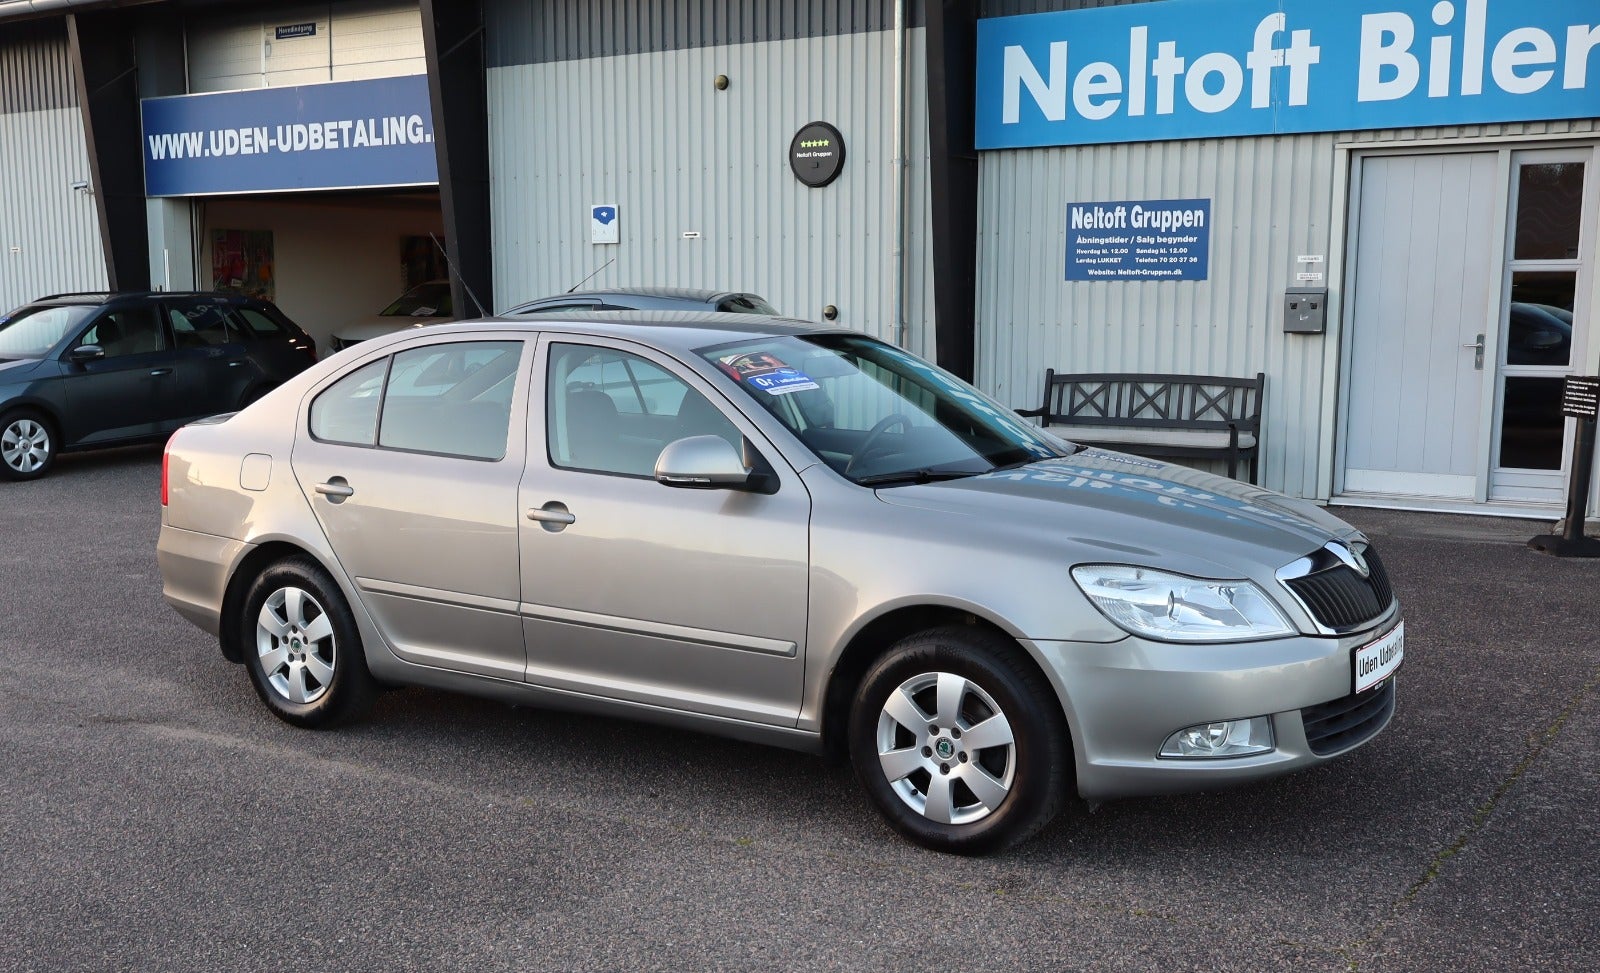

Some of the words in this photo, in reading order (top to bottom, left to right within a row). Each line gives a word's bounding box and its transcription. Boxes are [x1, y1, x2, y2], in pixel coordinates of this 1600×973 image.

[1003, 12, 1320, 124] Neltoft
[1358, 0, 1600, 102] Biler
[148, 114, 435, 160] WWW.UDEN-UDBETALING.
[1071, 205, 1127, 230] Neltoft
[1130, 204, 1205, 233] Gruppen
[1076, 235, 1129, 245] Åbningstider
[1130, 235, 1135, 245] /
[1136, 235, 1155, 245] Salg
[1156, 235, 1198, 244] begynder
[1117, 269, 1183, 277] Neltoft-Gruppen.dk
[1359, 656, 1378, 677] Uden
